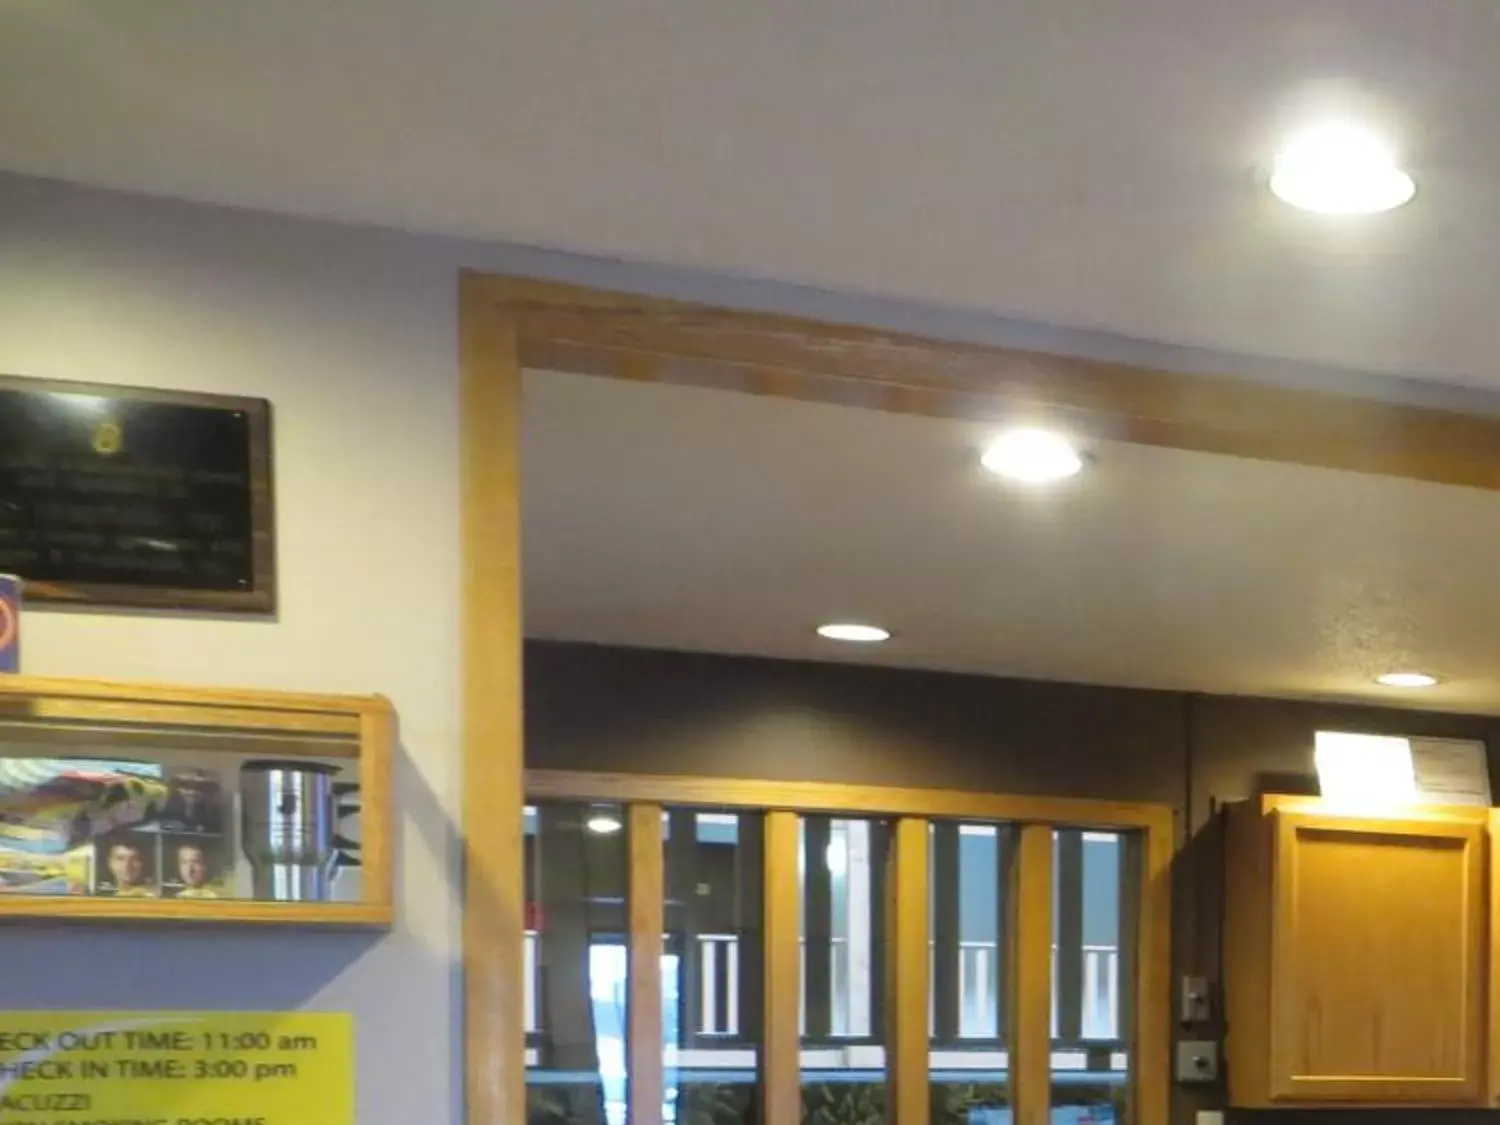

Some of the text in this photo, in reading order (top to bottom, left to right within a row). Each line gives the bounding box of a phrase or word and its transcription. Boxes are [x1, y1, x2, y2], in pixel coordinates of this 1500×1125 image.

[57, 1030, 117, 1051] OUT
[122, 1030, 193, 1051] TIME:
[201, 1031, 271, 1050] 11:00
[277, 1033, 318, 1050] am
[81, 1059, 108, 1079] IN
[114, 1058, 187, 1079] TIME:
[194, 1058, 248, 1079] 3:00
[254, 1062, 298, 1082] pm
